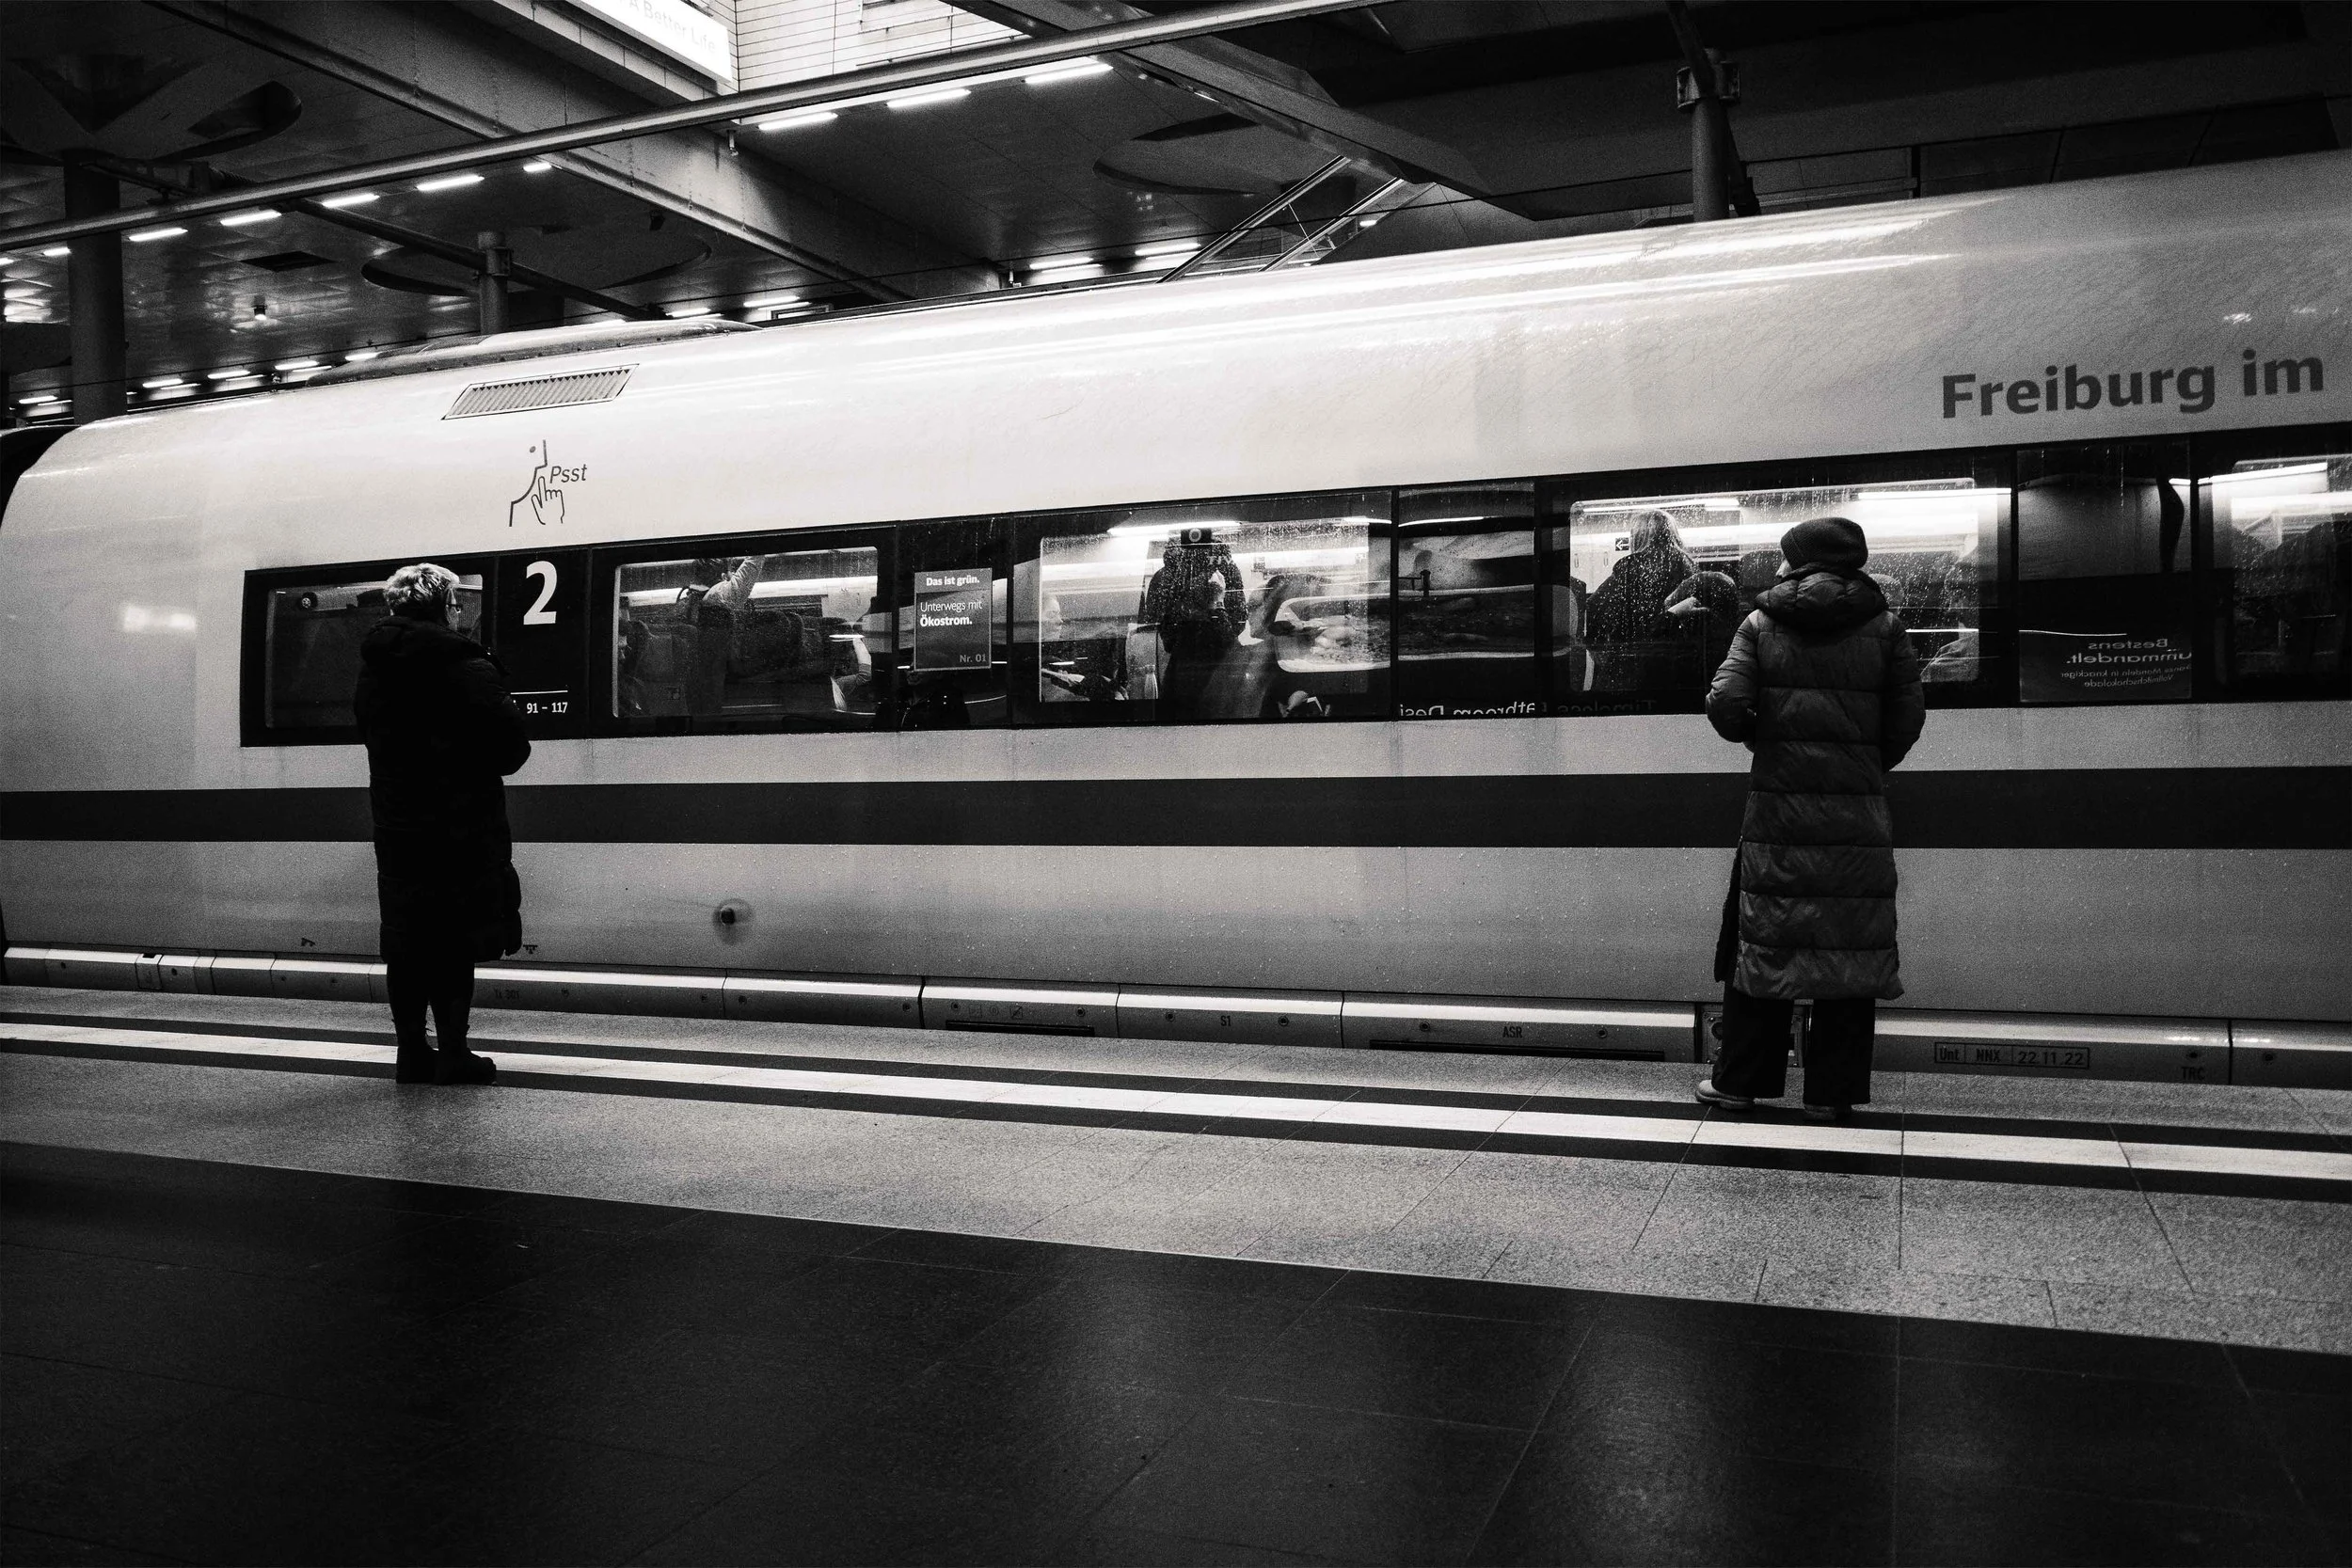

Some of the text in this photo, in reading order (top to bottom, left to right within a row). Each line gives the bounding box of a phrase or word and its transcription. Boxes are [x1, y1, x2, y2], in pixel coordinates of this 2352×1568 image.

[644, 0, 687, 39] Better
[691, 24, 717, 54] Life
[1942, 349, 2325, 420] Freiburg im
[549, 464, 588, 484] Psst
[926, 575, 980, 587] Das ist grün.
[523, 560, 558, 626] 2
[920, 599, 982, 613] Unterwegs mit
[919, 613, 973, 627] Ökostrom.
[959, 653, 987, 663] Nr. 01
[526, 702, 539, 715] 91
[551, 701, 568, 714] 117
[1502, 1026, 1523, 1038] ASR
